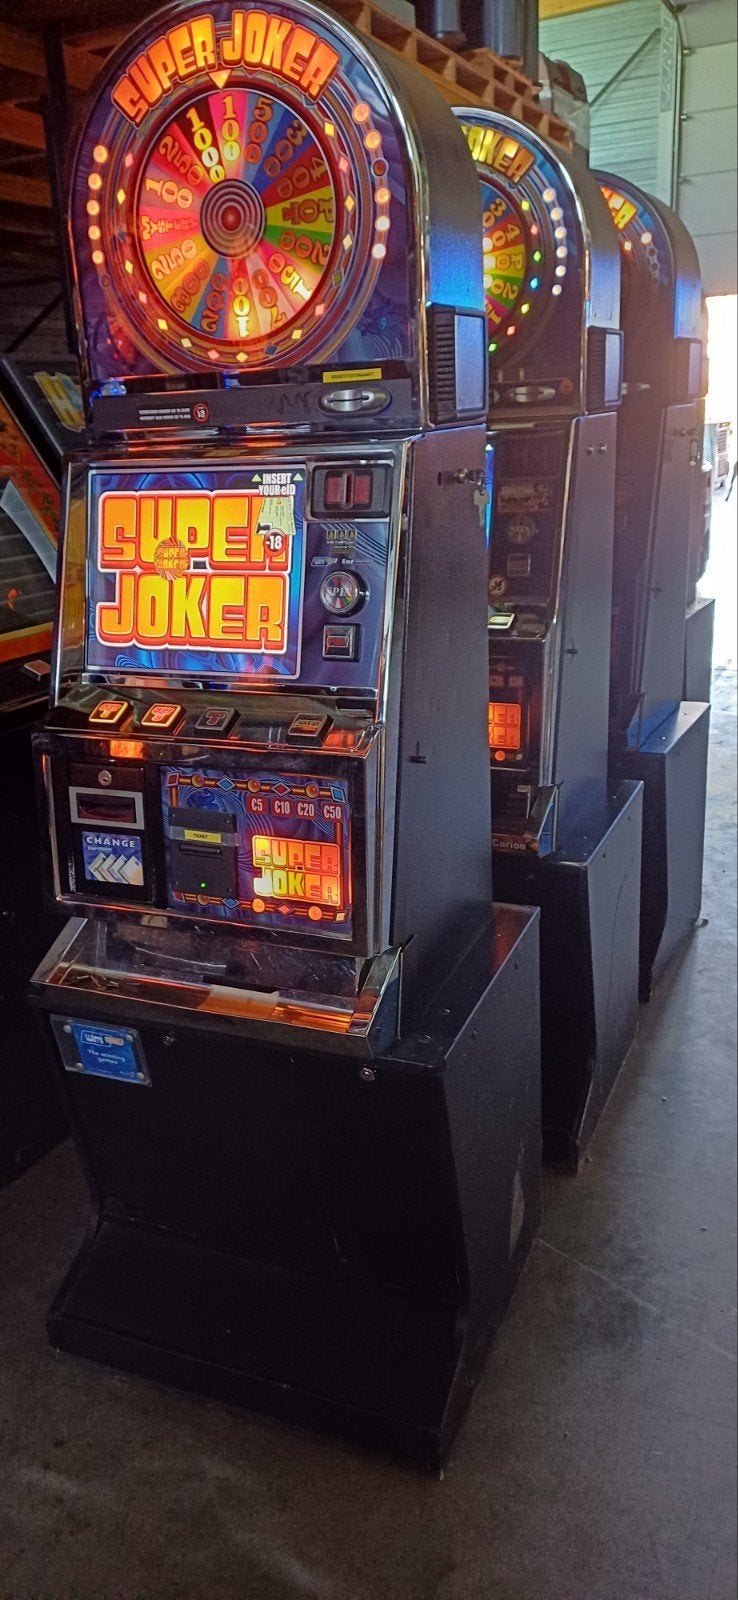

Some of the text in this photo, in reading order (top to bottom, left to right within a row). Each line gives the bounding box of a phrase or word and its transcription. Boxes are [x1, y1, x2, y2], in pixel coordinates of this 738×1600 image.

[112, 11, 341, 127] SUPER JOKER
[186, 107, 226, 184] 1000
[222, 96, 240, 163] 100
[244, 97, 273, 164] 500
[263, 118, 308, 178] 300
[461, 125, 535, 184] OKER
[159, 135, 204, 186] 250
[276, 155, 327, 199] 400
[145, 178, 193, 209] 100
[281, 198, 335, 225] POT
[483, 198, 507, 228] 30
[151, 238, 198, 280] 250
[279, 230, 331, 266] 200
[170, 258, 210, 314] 300
[268, 252, 313, 301] 150
[200, 272, 227, 333] 200
[232, 277, 251, 337] 100
[262, 473, 292, 484] INSERT
[101, 494, 288, 569] SUPER
[98, 573, 287, 650] JOKER
[86, 836, 136, 848] CHANGE
[254, 837, 339, 873] SUPER
[254, 867, 339, 904] JOKER
[87, 1048, 99, 1056] The
